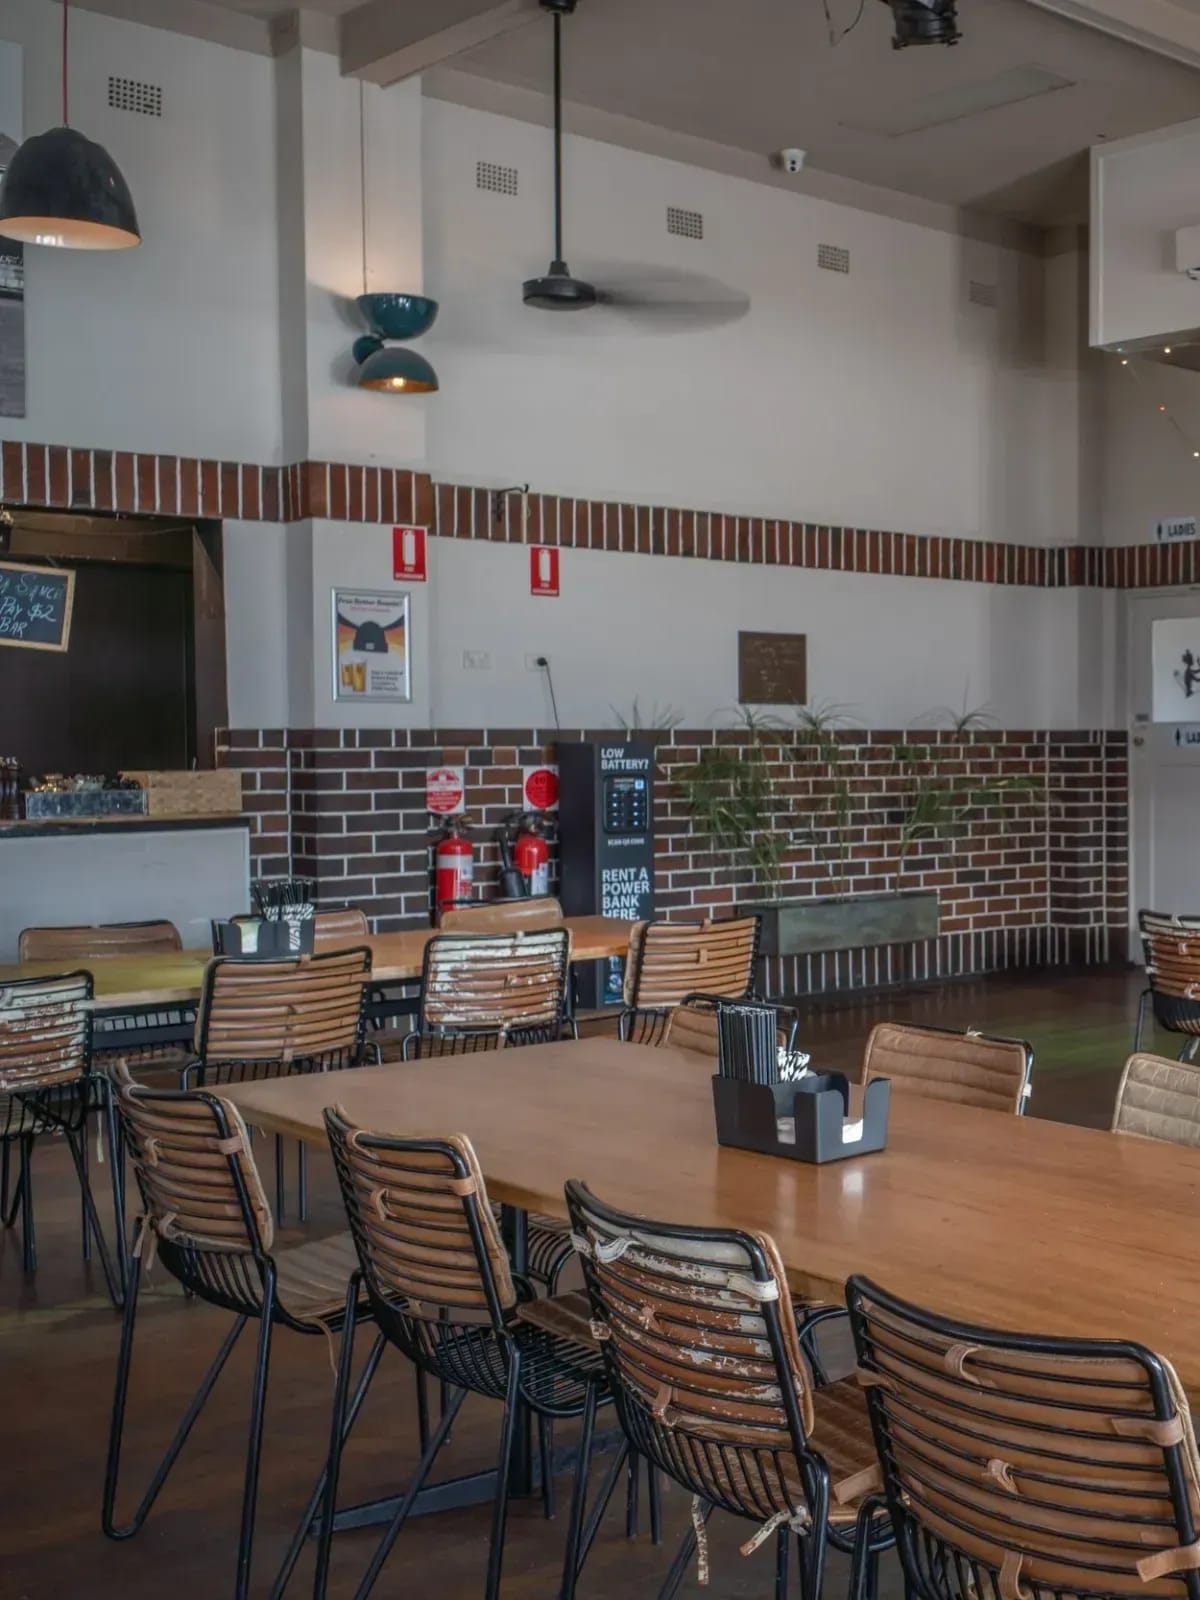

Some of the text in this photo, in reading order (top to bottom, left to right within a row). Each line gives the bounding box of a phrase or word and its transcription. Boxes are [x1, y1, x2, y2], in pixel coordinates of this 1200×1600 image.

[1167, 522, 1196, 537] LADIES
[601, 748, 624, 758] LOW
[601, 759, 649, 770] BATTERY?
[603, 866, 648, 882] RENT A
[603, 881, 650, 896] POWER
[602, 894, 640, 909] BANK
